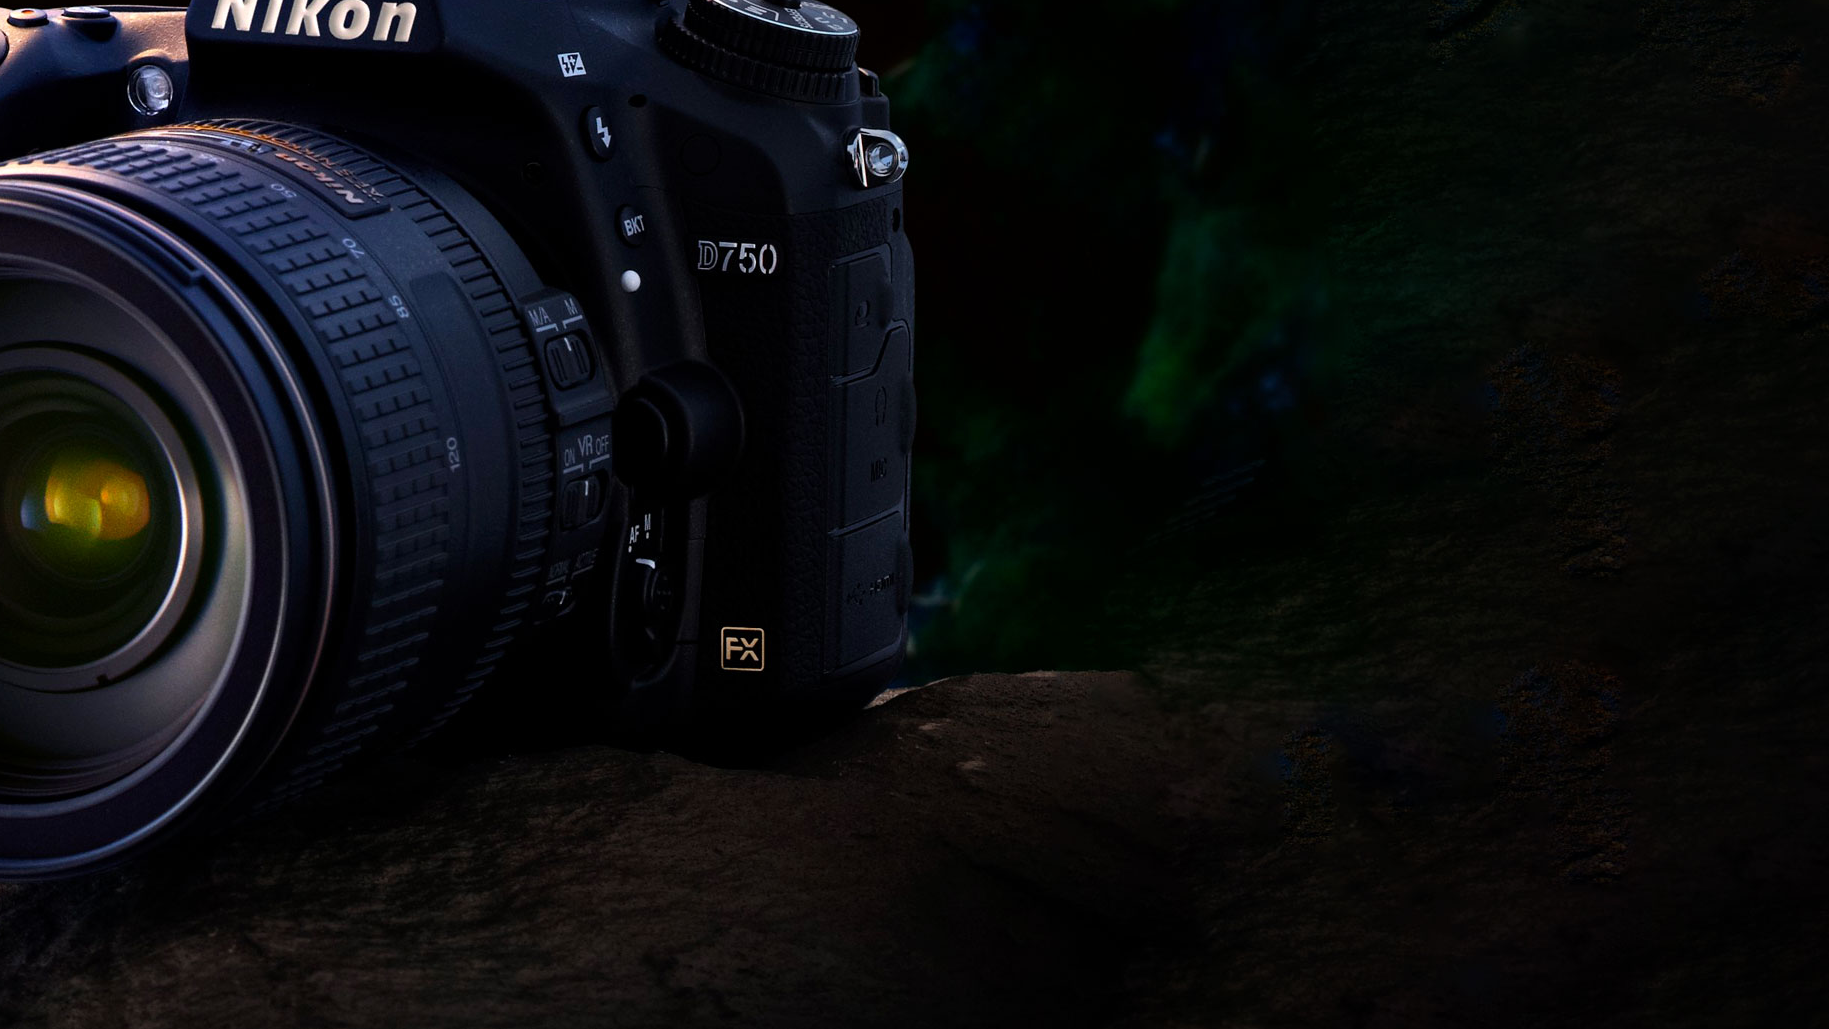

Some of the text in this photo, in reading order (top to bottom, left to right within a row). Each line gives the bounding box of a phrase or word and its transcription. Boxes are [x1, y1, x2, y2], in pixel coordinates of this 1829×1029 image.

[270, 183, 298, 199] 50
[275, 152, 366, 205] Nikon
[623, 214, 645, 237] BKT
[341, 237, 366, 260] 70
[696, 238, 778, 275] D750
[387, 294, 411, 319] 85
[563, 296, 579, 316] M
[445, 436, 461, 473] 120
[563, 434, 610, 468] ON VR OFF
[628, 524, 641, 545] AF
[724, 634, 762, 664] FX
